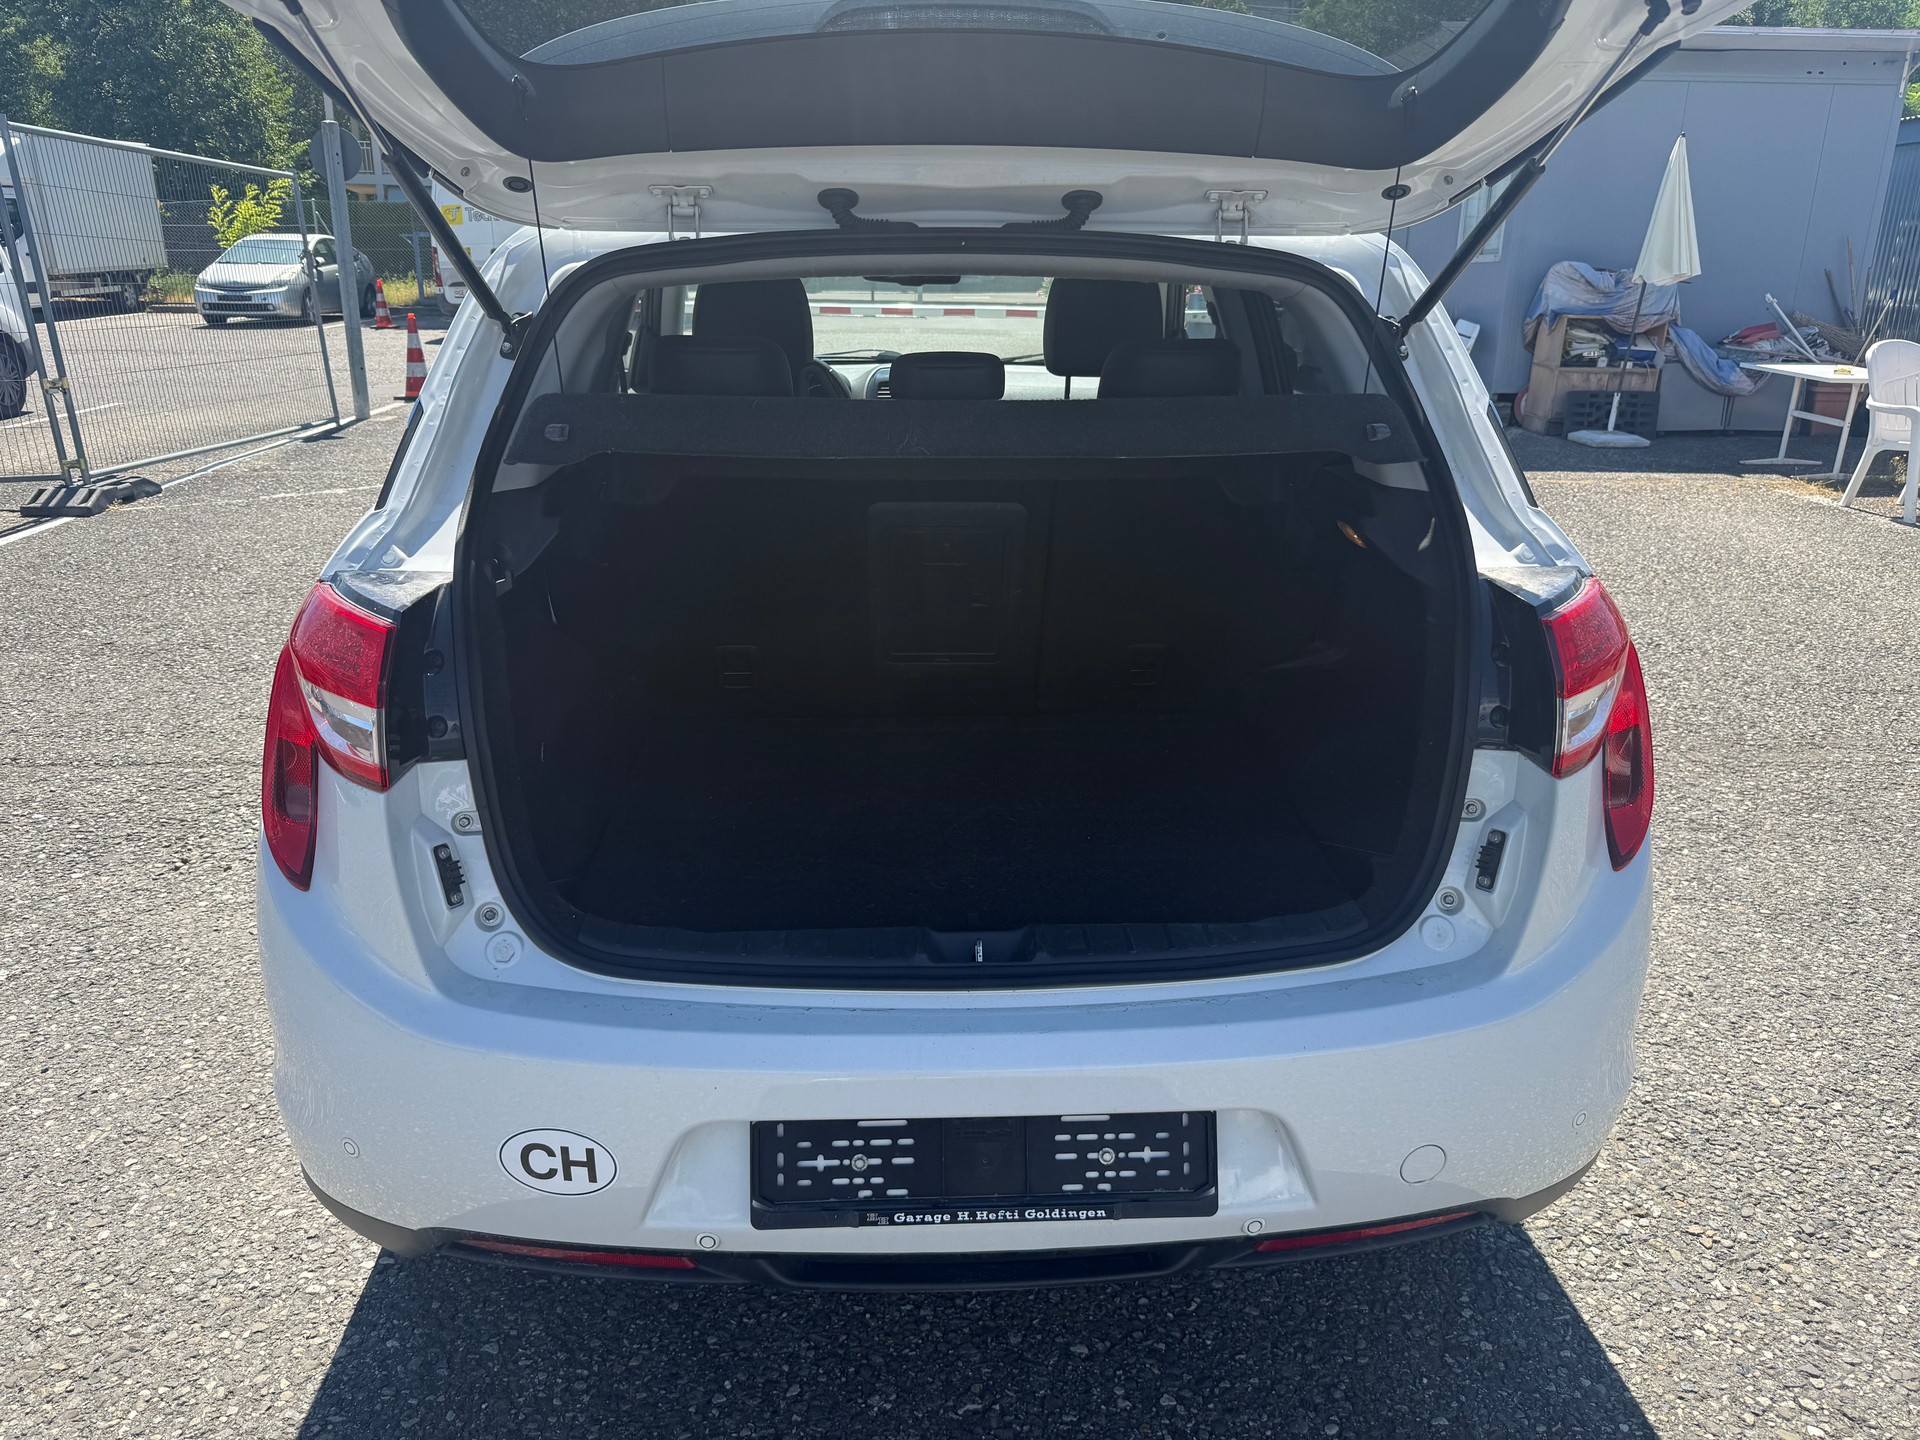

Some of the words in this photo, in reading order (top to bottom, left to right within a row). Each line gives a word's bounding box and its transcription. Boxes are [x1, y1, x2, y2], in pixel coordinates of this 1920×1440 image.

[520, 1142, 598, 1184] CH
[893, 1212, 951, 1224] Garage
[1024, 1208, 1107, 1219] Goldingen
